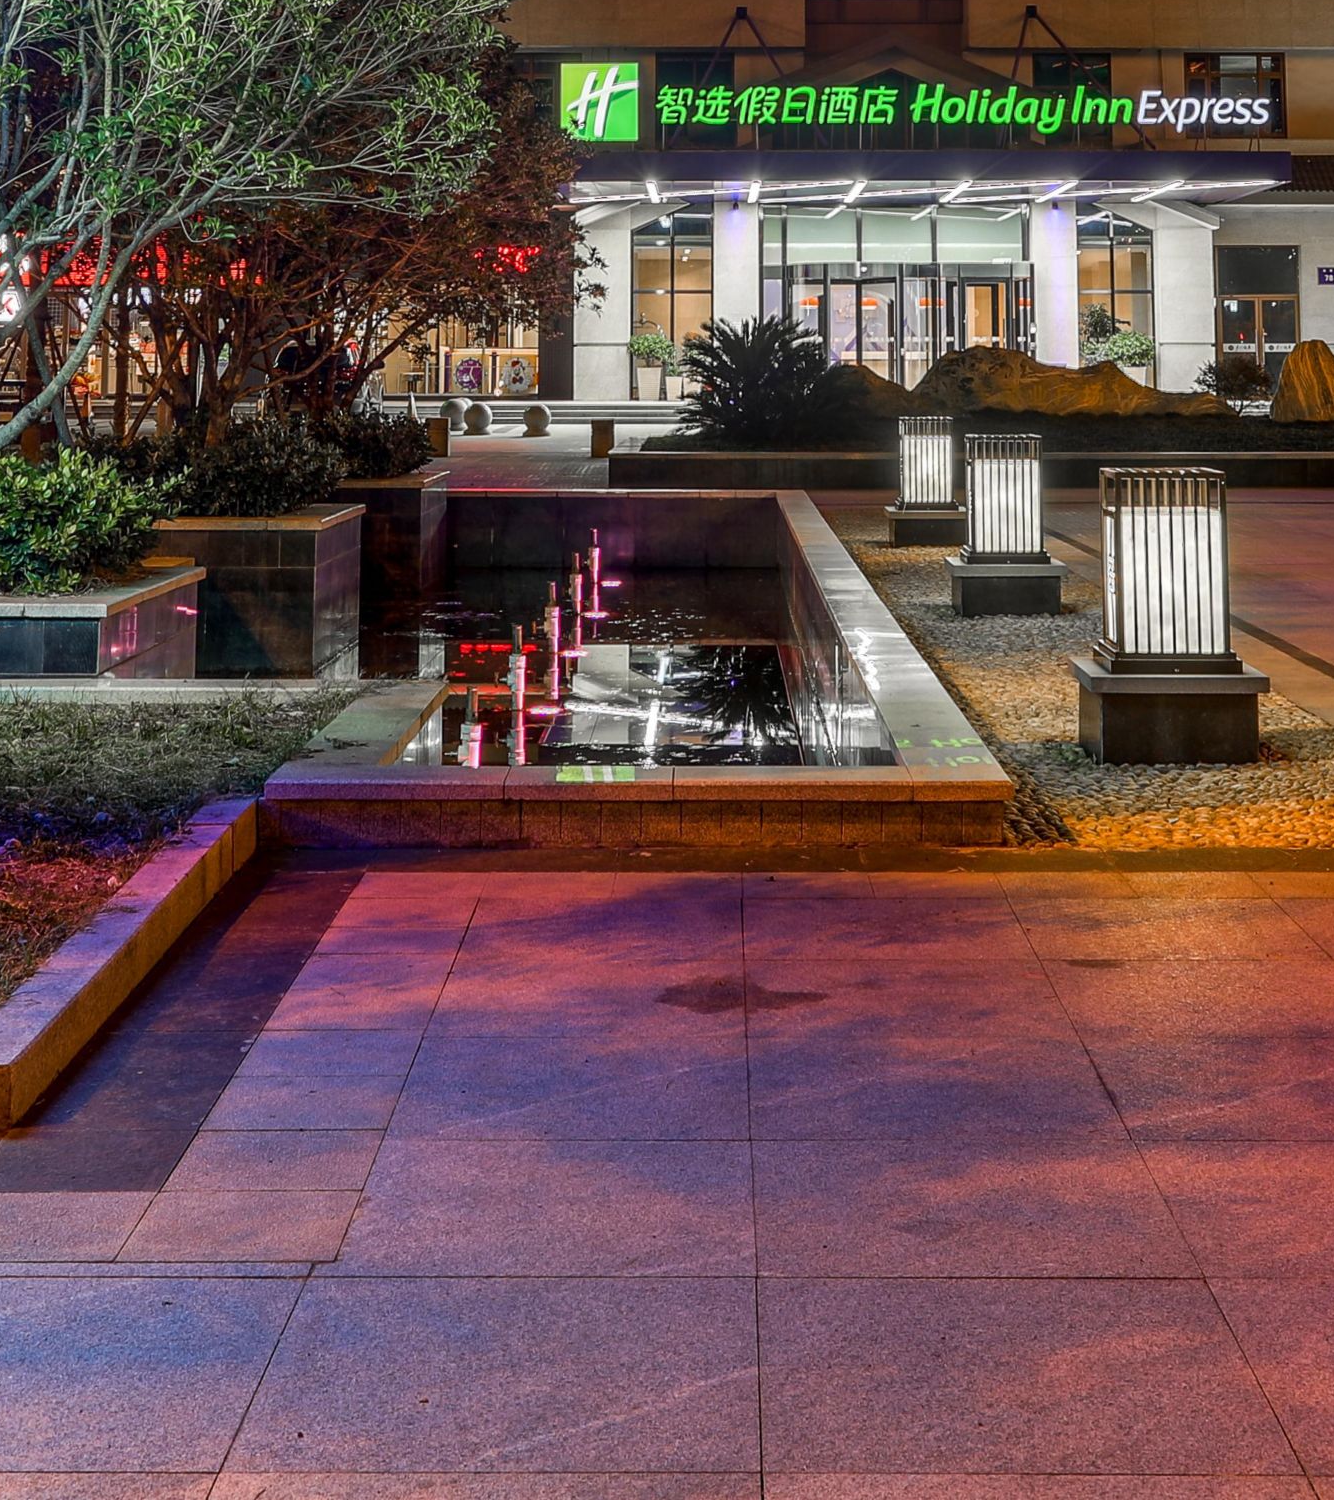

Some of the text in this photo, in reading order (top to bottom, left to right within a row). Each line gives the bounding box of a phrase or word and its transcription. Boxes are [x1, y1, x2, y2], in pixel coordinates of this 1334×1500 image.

[654, 84, 898, 127] 智选假日酒店
[910, 83, 1272, 135] Holiday Inn Express
